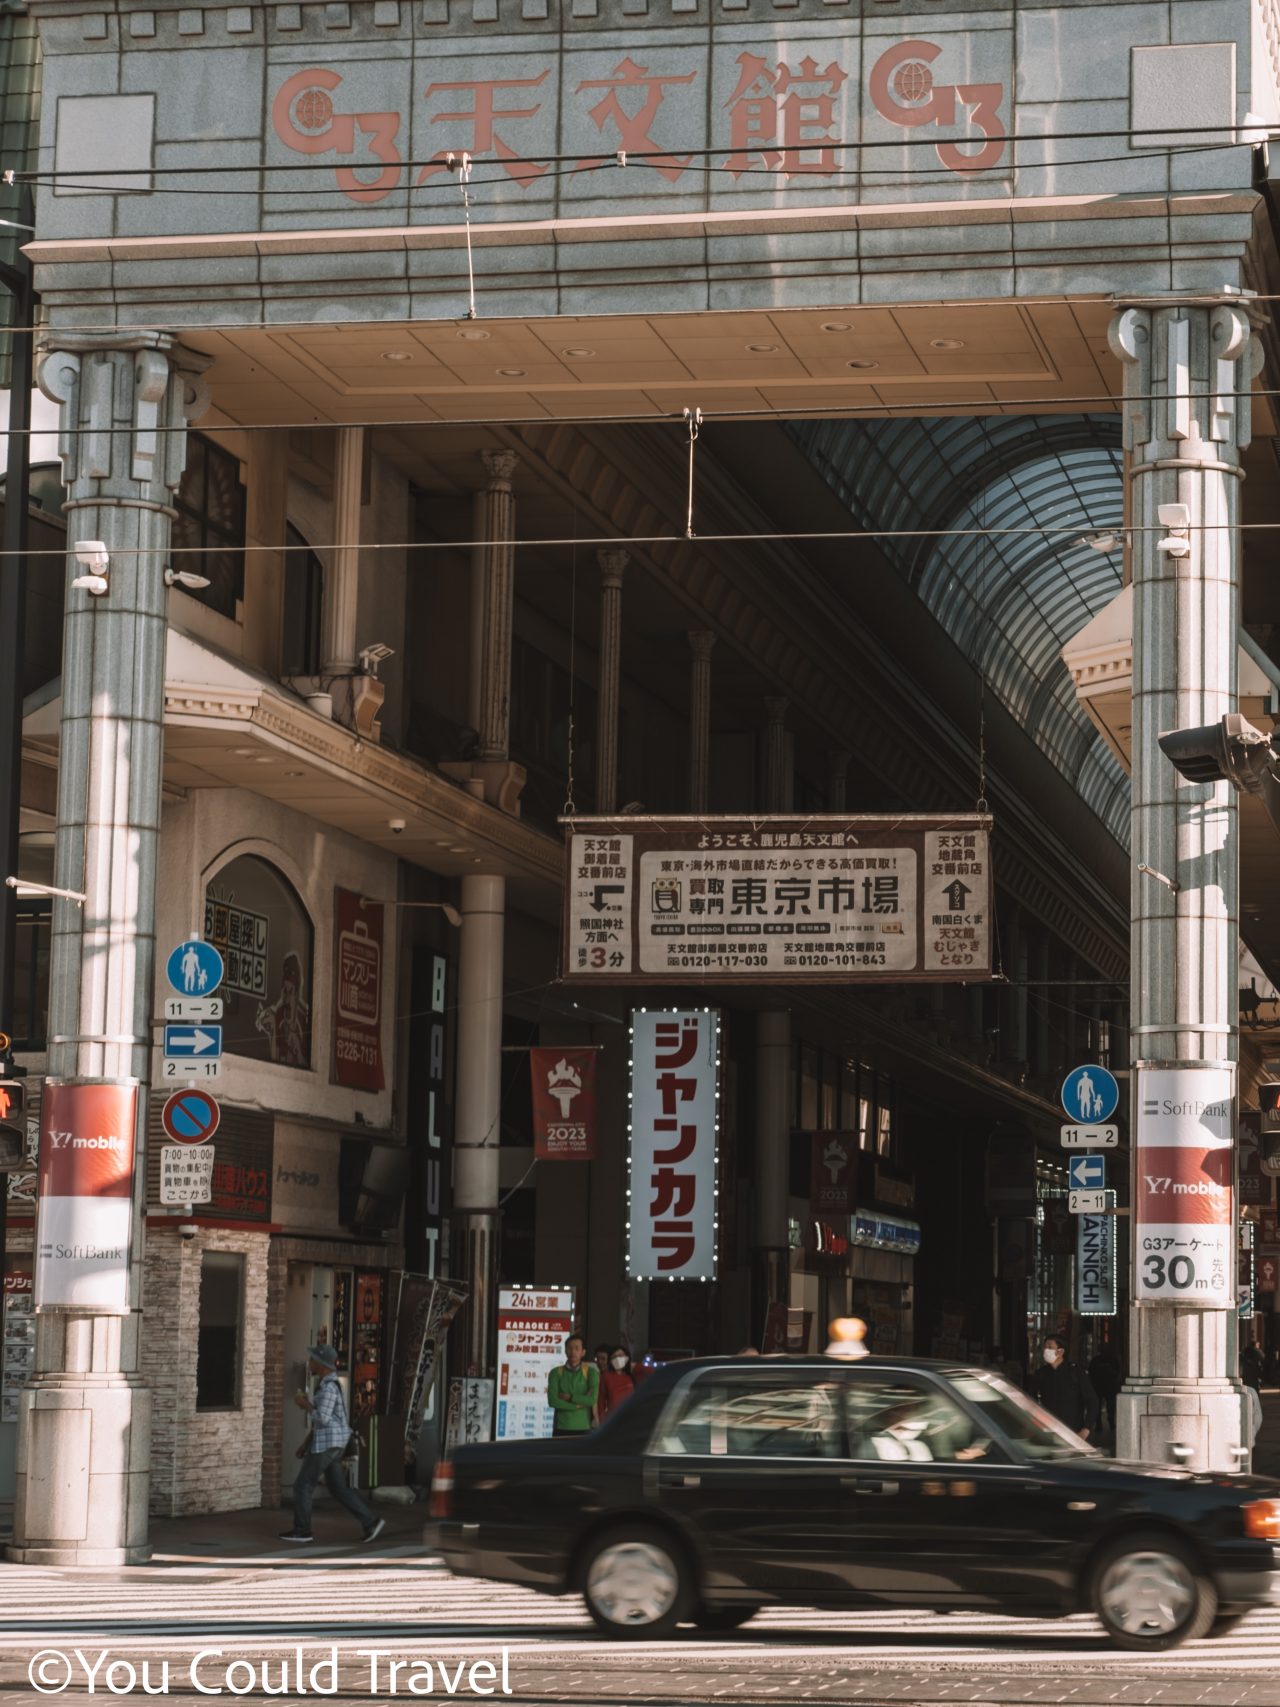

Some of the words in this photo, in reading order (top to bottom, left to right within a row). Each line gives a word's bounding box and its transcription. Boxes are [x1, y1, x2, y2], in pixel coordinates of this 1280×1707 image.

[416, 51, 849, 190] 天文館
[584, 840, 621, 851] 天文館
[697, 833, 860, 848] ようこそ、鹿児島天文館へ
[938, 836, 976, 848] 天文館
[577, 866, 627, 879] 交番前店
[932, 863, 982, 875] 交番前店
[731, 876, 900, 916] 東京市場
[585, 932, 619, 943] 方面へ
[939, 928, 976, 939] 天文館
[933, 941, 979, 952] むじゃき
[681, 956, 768, 967] 0120-117-030
[798, 954, 886, 966] 0120-101-843
[939, 953, 974, 965] となり
[342, 957, 376, 986] マンスリー
[1162, 1100, 1228, 1118] SoftBank
[547, 1127, 587, 1140] 2023
[649, 1018, 698, 1271] ジャンカラ
[166, 1189, 209, 1201] ここから
[55, 1243, 122, 1260] SoftBank
[1083, 1212, 1099, 1304] ANNICHI
[505, 1321, 550, 1330] KARAOKE
[517, 1333, 562, 1344] ジャンカラ
